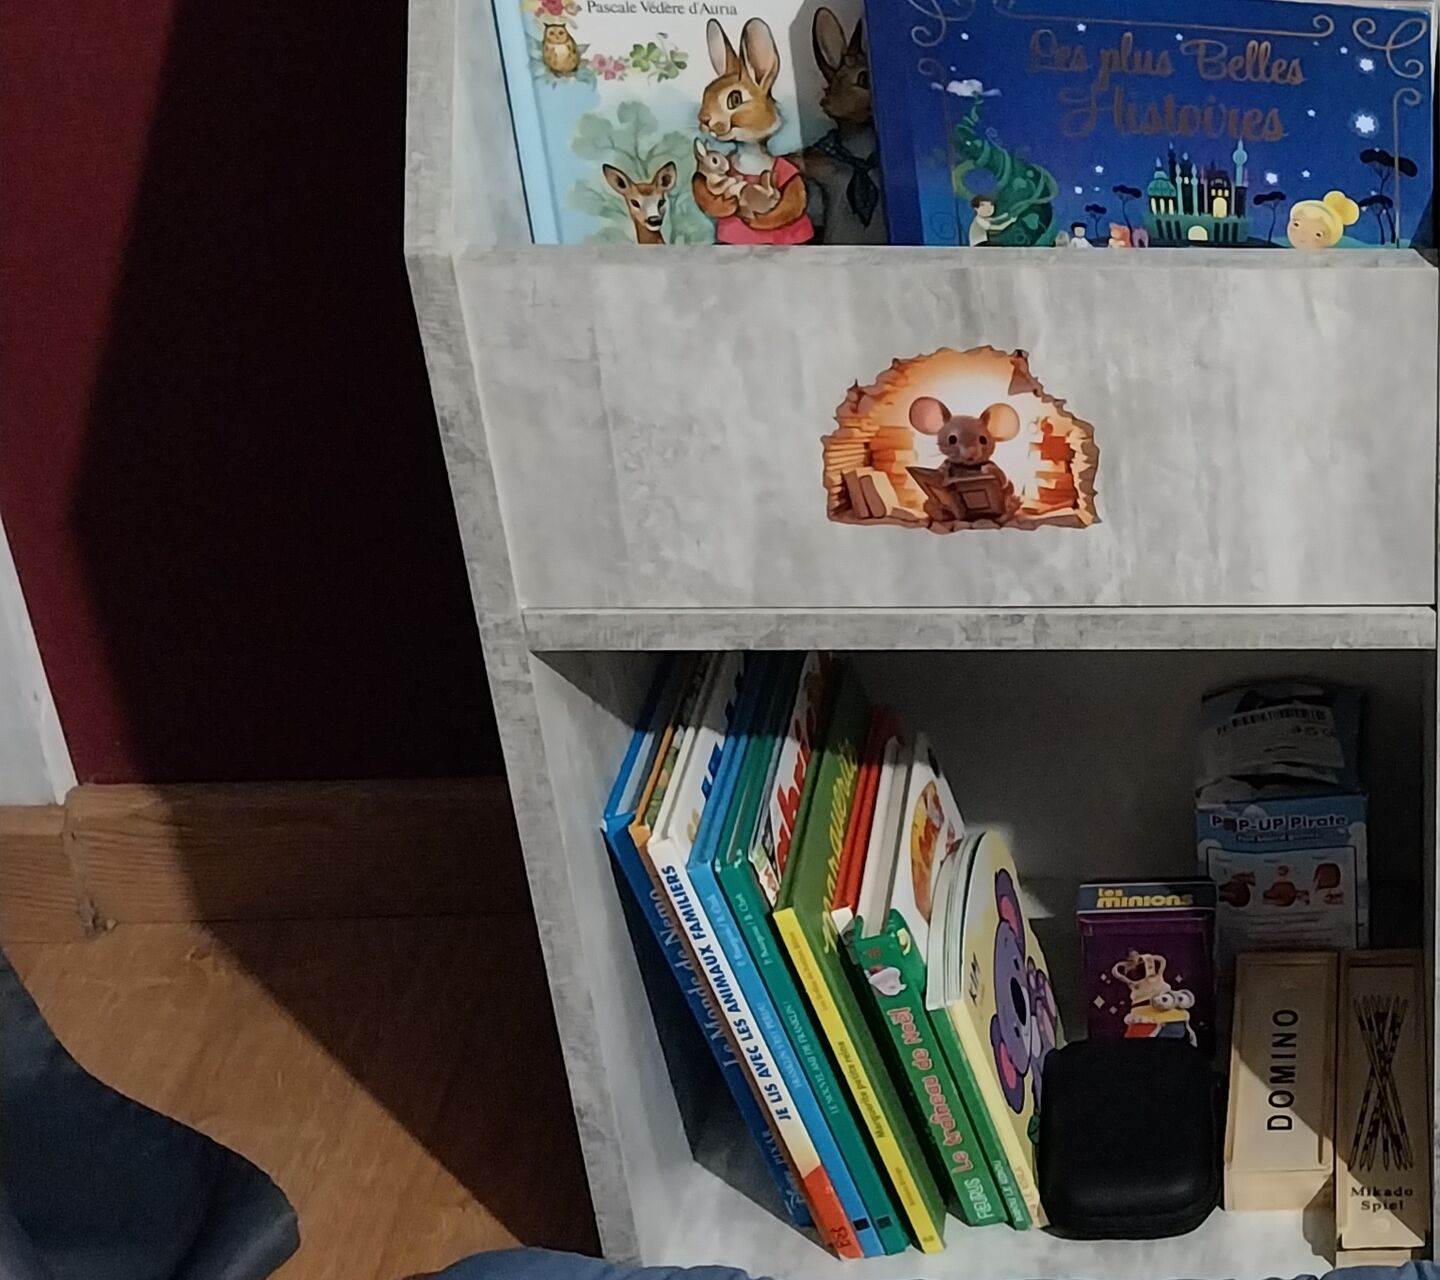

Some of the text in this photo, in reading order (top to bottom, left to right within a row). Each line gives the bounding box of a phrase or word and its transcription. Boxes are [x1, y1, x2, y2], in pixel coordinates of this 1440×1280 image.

[586, 0, 637, 16] Pascale
[688, 1, 738, 17] d'Auria
[1029, 29, 1305, 92] Les plus Belles
[1061, 82, 1288, 142] Histoires
[1290, 813, 1347, 830] Pirate
[661, 864, 791, 1121] JE LIS AVEC LES ANIMAUX FAMILIERS
[836, 1041, 887, 1138] Marguerite petite reine
[887, 1007, 974, 1173] Le traîneau de Noël
[1267, 1008, 1299, 1132] DOMINO
[1351, 1186, 1413, 1197] Mikado
[1361, 1200, 1403, 1213] Spiel
